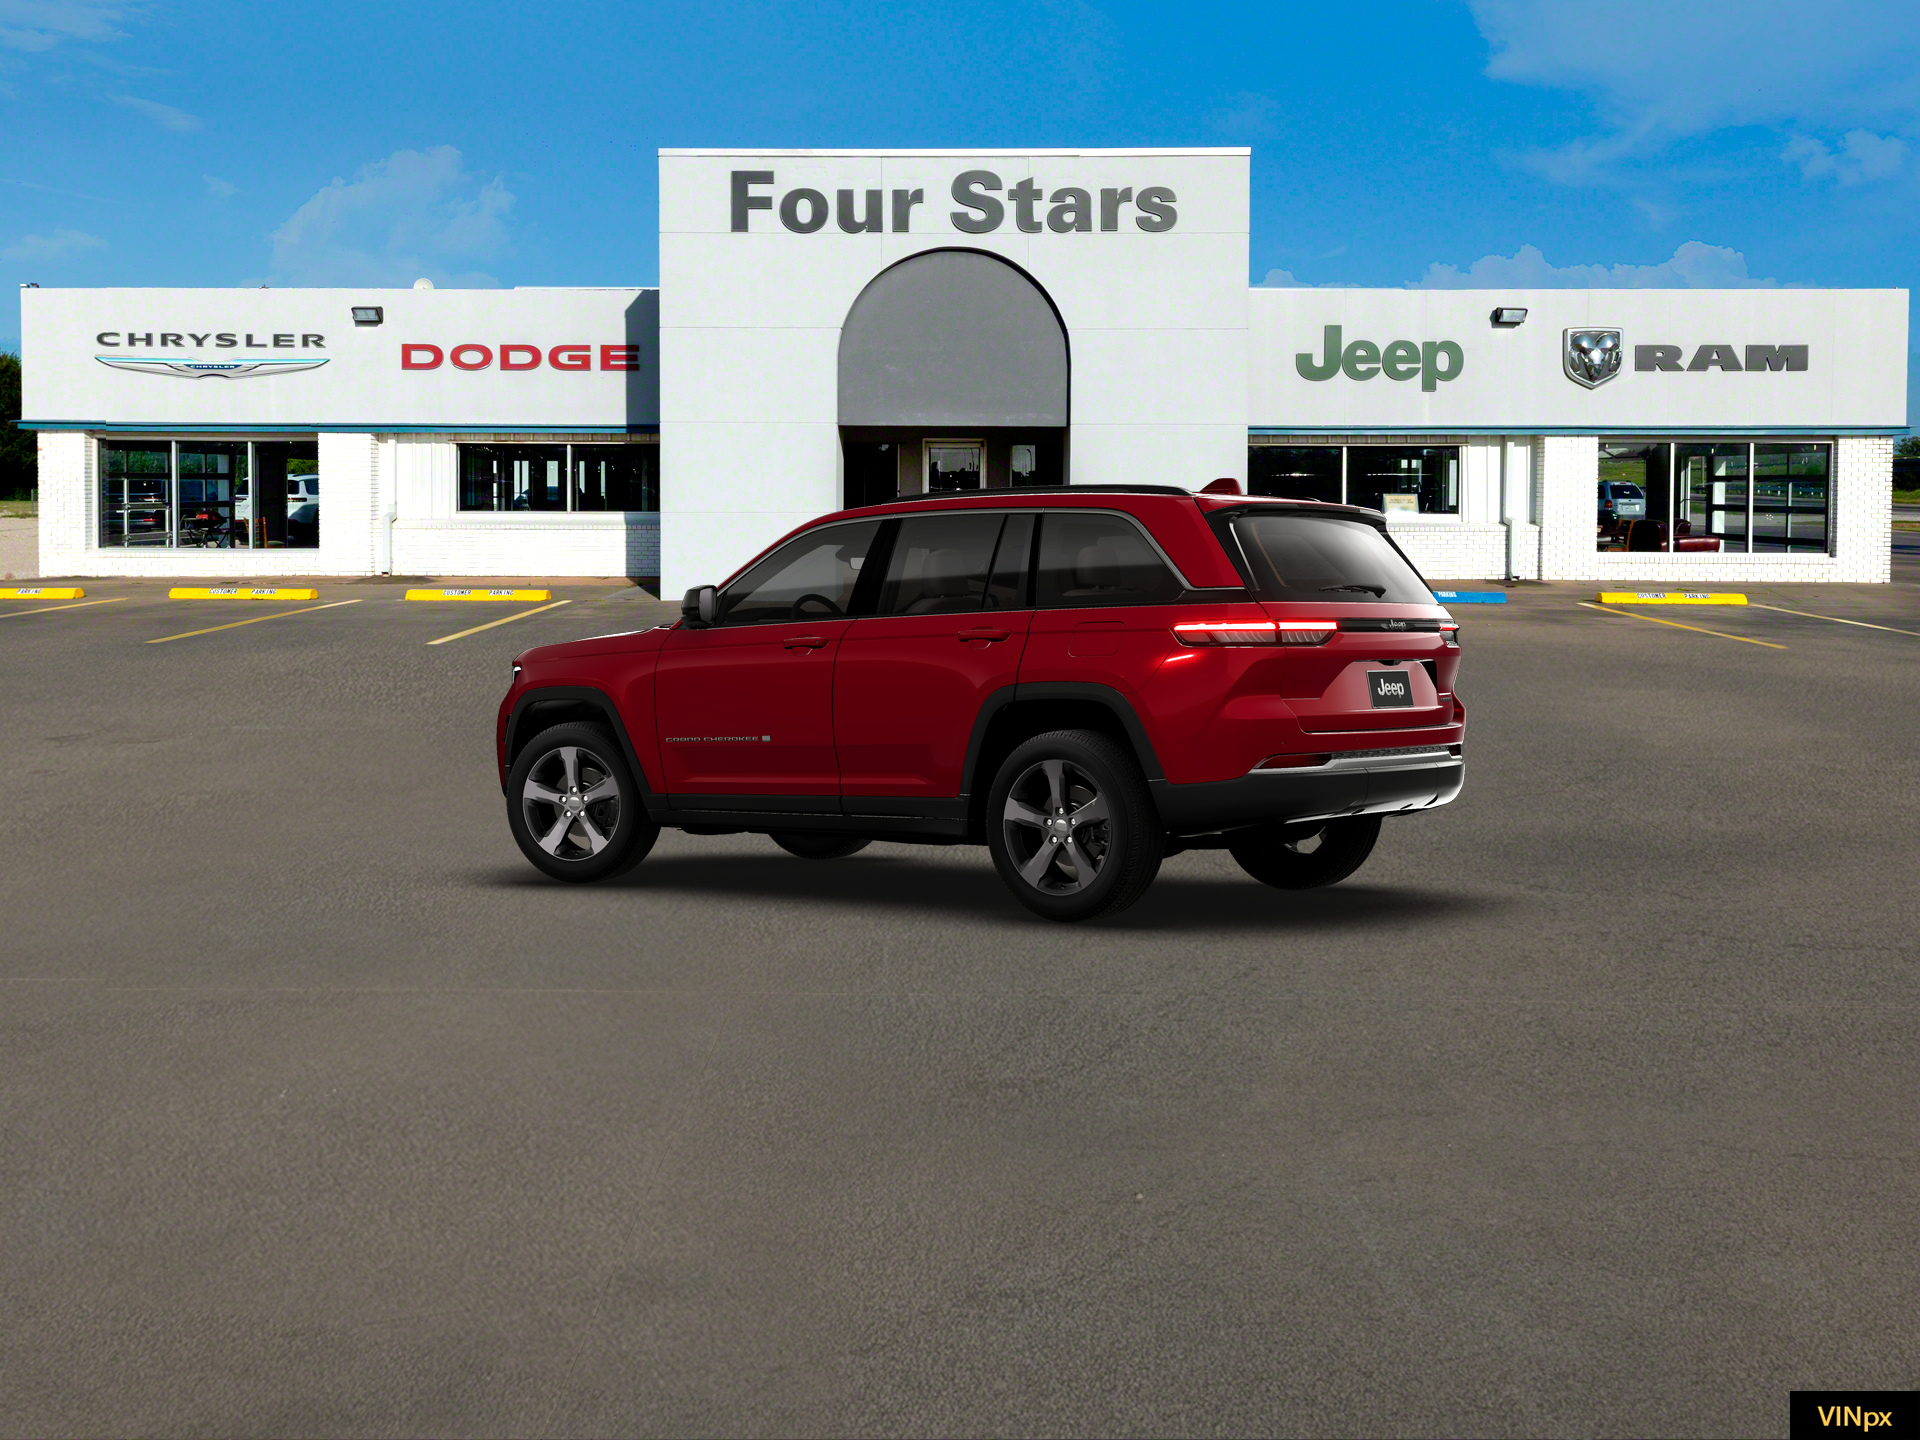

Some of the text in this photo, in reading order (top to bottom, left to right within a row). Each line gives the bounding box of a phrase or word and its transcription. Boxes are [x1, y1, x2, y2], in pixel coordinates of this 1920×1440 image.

[730, 169, 1178, 234] Four Stars
[96, 332, 326, 349] CHRYSLER
[401, 343, 640, 371] DODGE
[1295, 325, 1464, 392] Jeep
[1634, 344, 1809, 372] RAM
[1388, 619, 1407, 632] Jeep
[1377, 678, 1405, 699] Jeep
